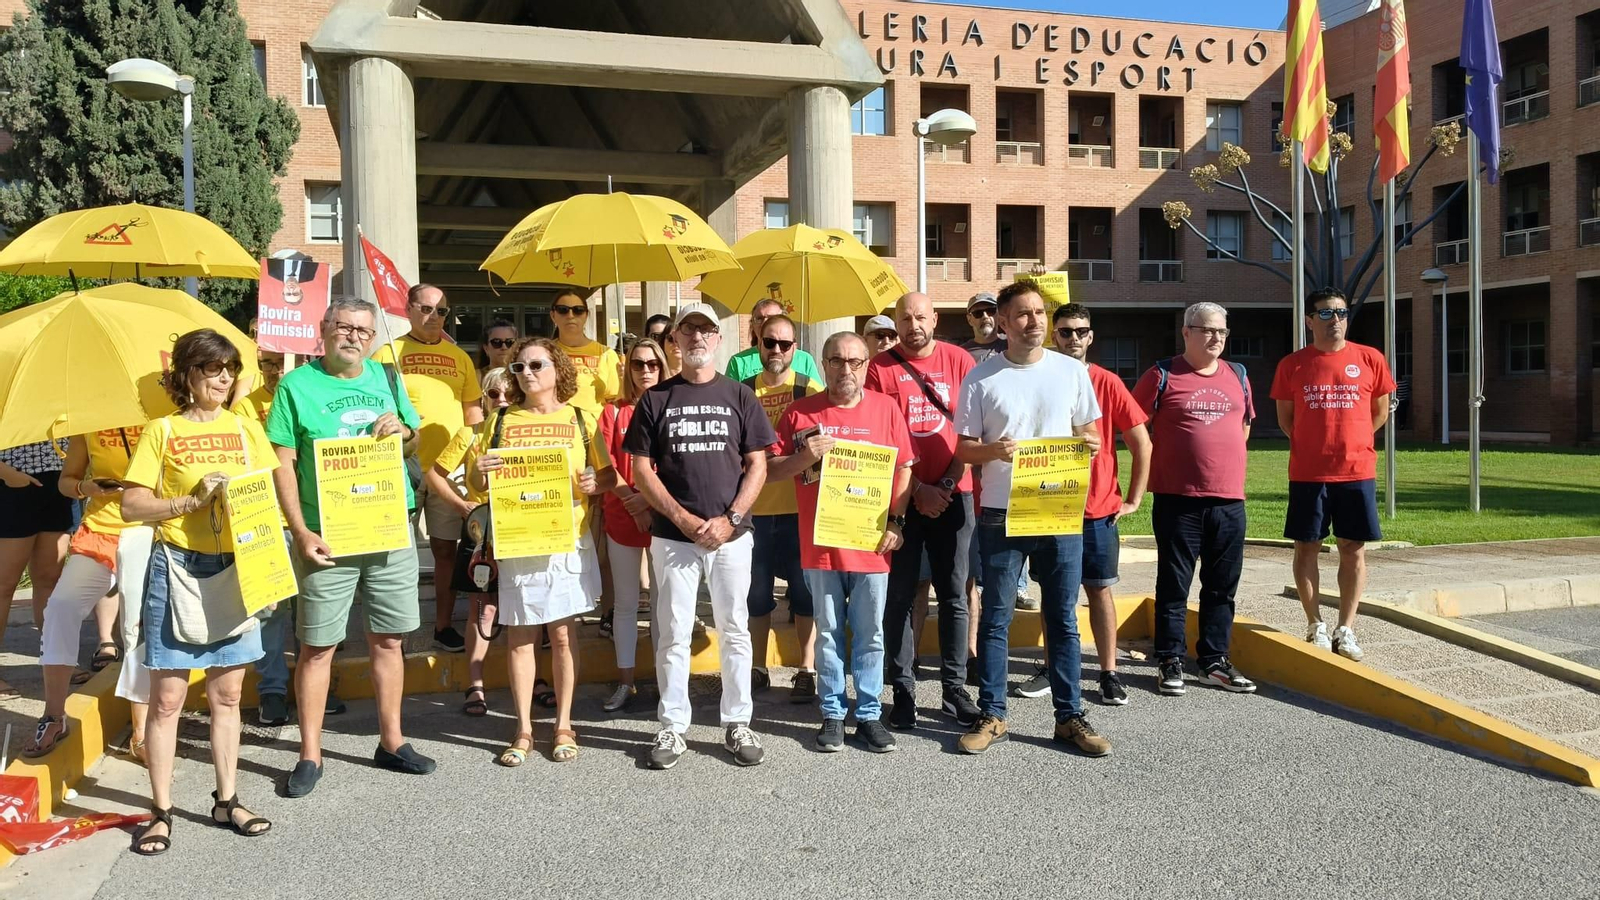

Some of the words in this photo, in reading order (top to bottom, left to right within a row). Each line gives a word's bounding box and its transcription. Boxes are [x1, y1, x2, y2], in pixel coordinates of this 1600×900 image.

[1012, 22, 1267, 66] D'EDUCACIÓ
[876, 48, 958, 78] URA
[994, 54, 1000, 81] I
[1036, 56, 1197, 92] ESPORT
[259, 304, 301, 322] Rovira
[259, 322, 315, 338] dimissió
[403, 366, 458, 378] educació
[326, 394, 384, 413] ESTIMEM
[1320, 401, 1354, 409] qualitat
[666, 408, 681, 418] PER
[682, 406, 699, 415] UNA
[701, 405, 732, 416] ESCOLA
[909, 413, 940, 425] pública
[668, 418, 729, 438] PÚBLICA
[322, 446, 356, 457] ROVIRA
[358, 440, 395, 454] DIMISSIÓ
[677, 443, 687, 452] DE
[688, 442, 727, 453] QUALITAT
[1019, 445, 1047, 456] ROVIRA
[323, 457, 358, 472] PROU
[369, 453, 396, 461] MENTIDES
[527, 452, 562, 464] DIMISSIÓ
[859, 450, 891, 463] DIMISSIÓ
[1018, 456, 1048, 469] PROU
[828, 457, 857, 471] PROU
[866, 462, 889, 471] MENTIDES
[495, 466, 527, 480] PROU
[229, 477, 267, 499] DIMISSIÓ
[376, 480, 394, 492] 10h
[1063, 479, 1079, 489] 10h
[240, 492, 269, 505] MENTIDES
[352, 492, 396, 504] concentració
[544, 489, 560, 500] 10h
[867, 486, 881, 498] 10h
[521, 500, 563, 510] concentració
[845, 496, 881, 506] concentració
[254, 523, 272, 538] 10h
[240, 538, 276, 555] concentració
